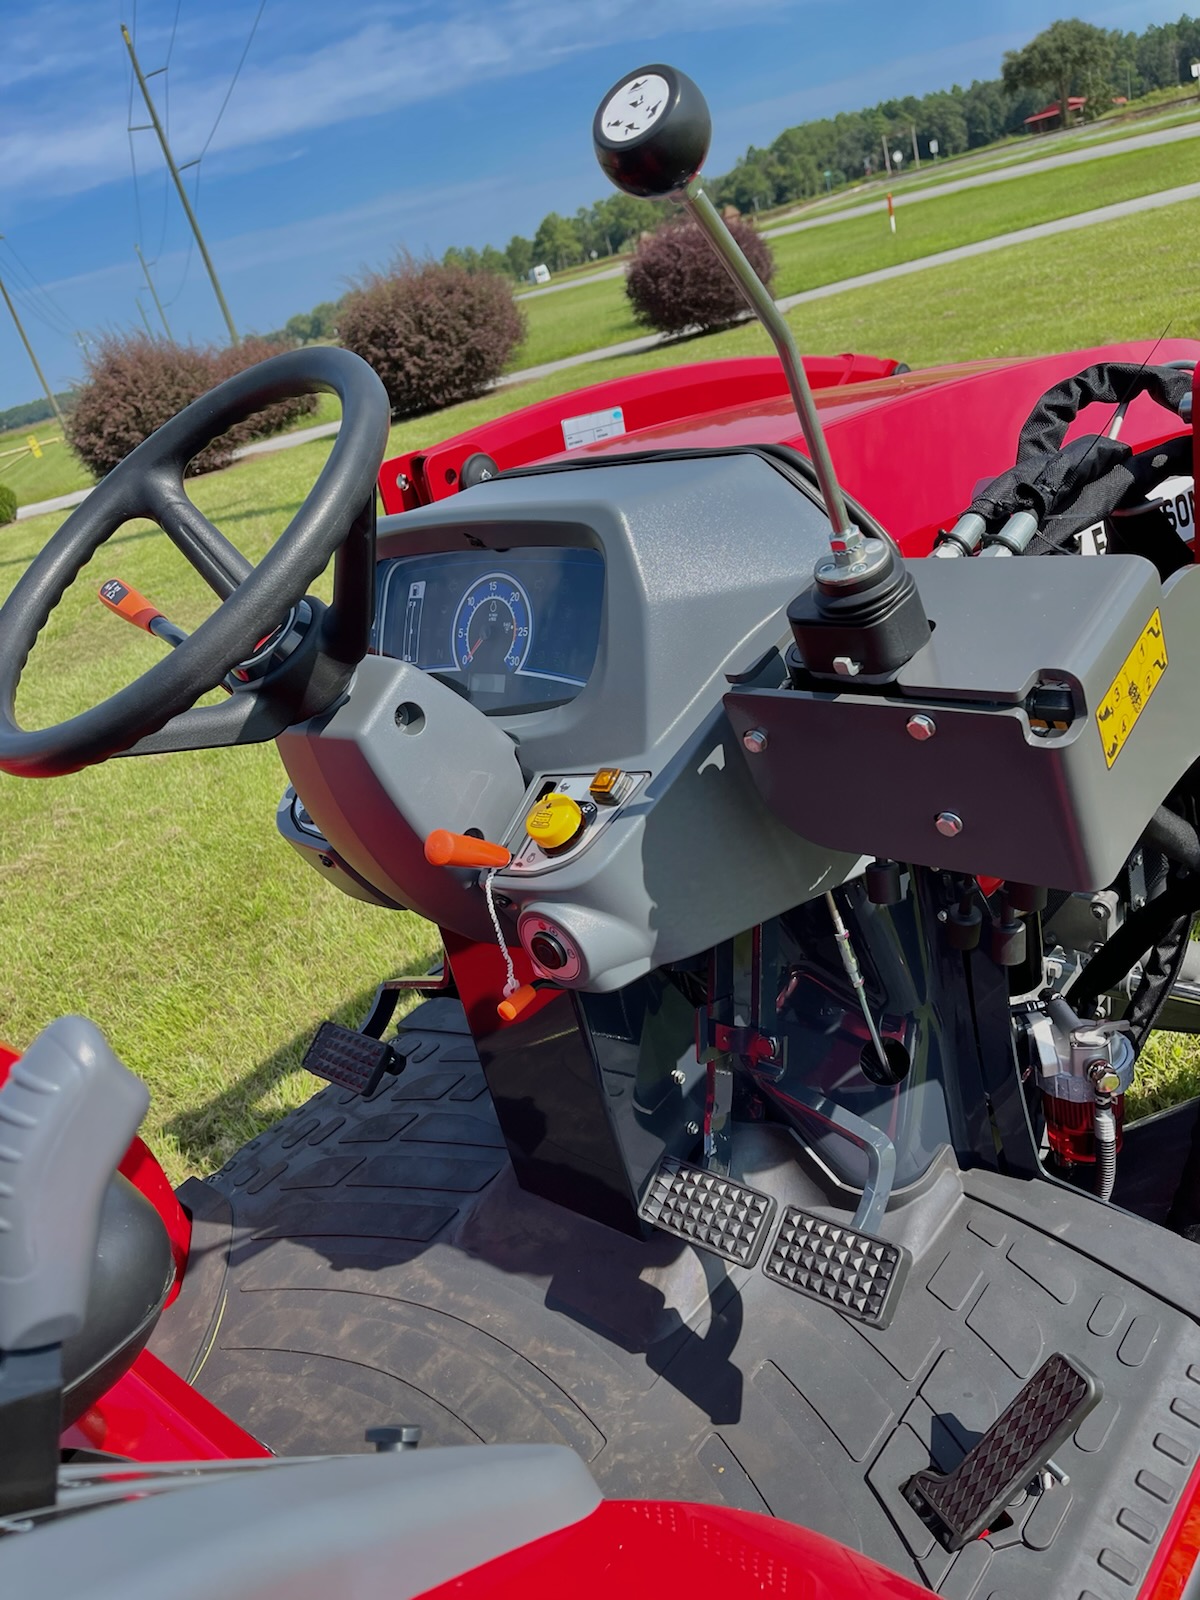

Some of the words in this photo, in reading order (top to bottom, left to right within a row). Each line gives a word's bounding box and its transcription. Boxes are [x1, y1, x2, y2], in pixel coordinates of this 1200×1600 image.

[489, 581, 497, 591] 15
[467, 596, 475, 606] 10
[510, 592, 520, 602] 20
[458, 628, 464, 638] 5
[518, 627, 528, 637] 25
[509, 656, 520, 666] 30
